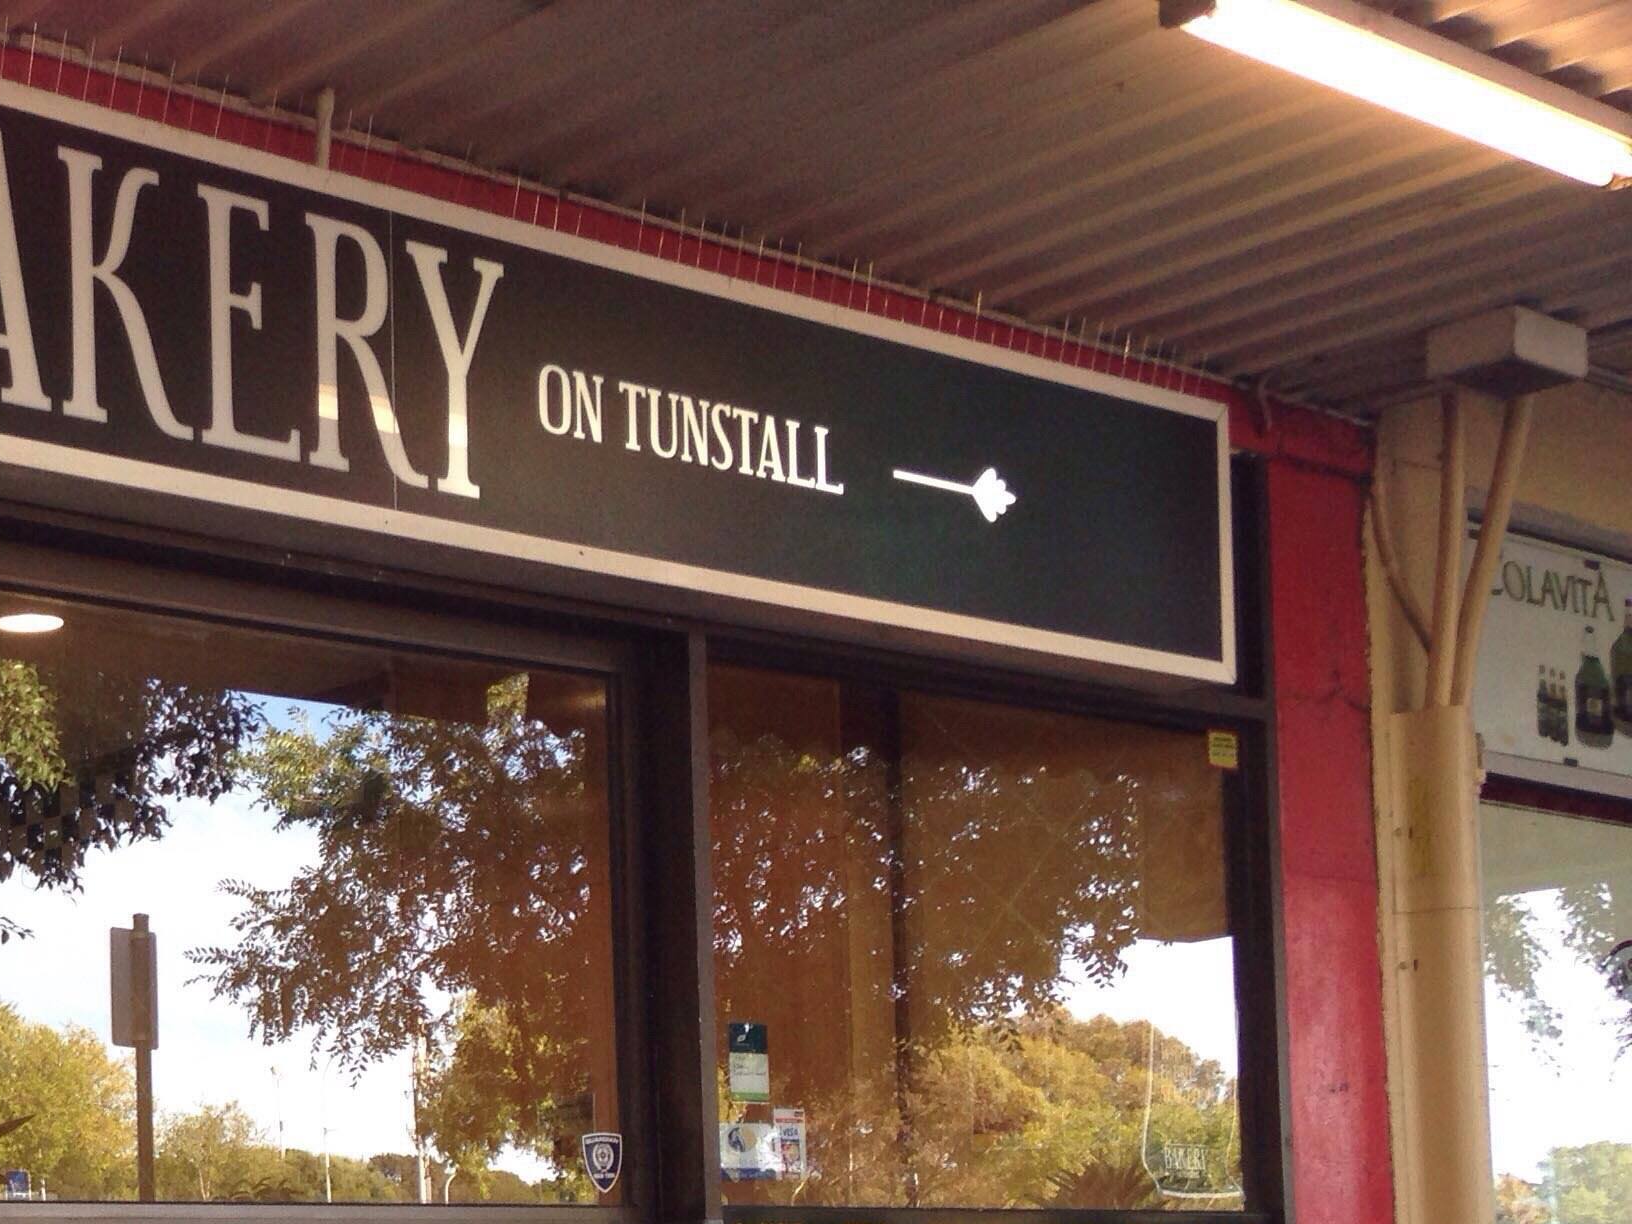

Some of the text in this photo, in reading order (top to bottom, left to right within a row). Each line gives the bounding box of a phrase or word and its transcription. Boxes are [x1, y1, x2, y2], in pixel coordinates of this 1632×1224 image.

[539, 364, 844, 495] ON TUNSTALL
[1502, 560, 1615, 621] OLAVITA
